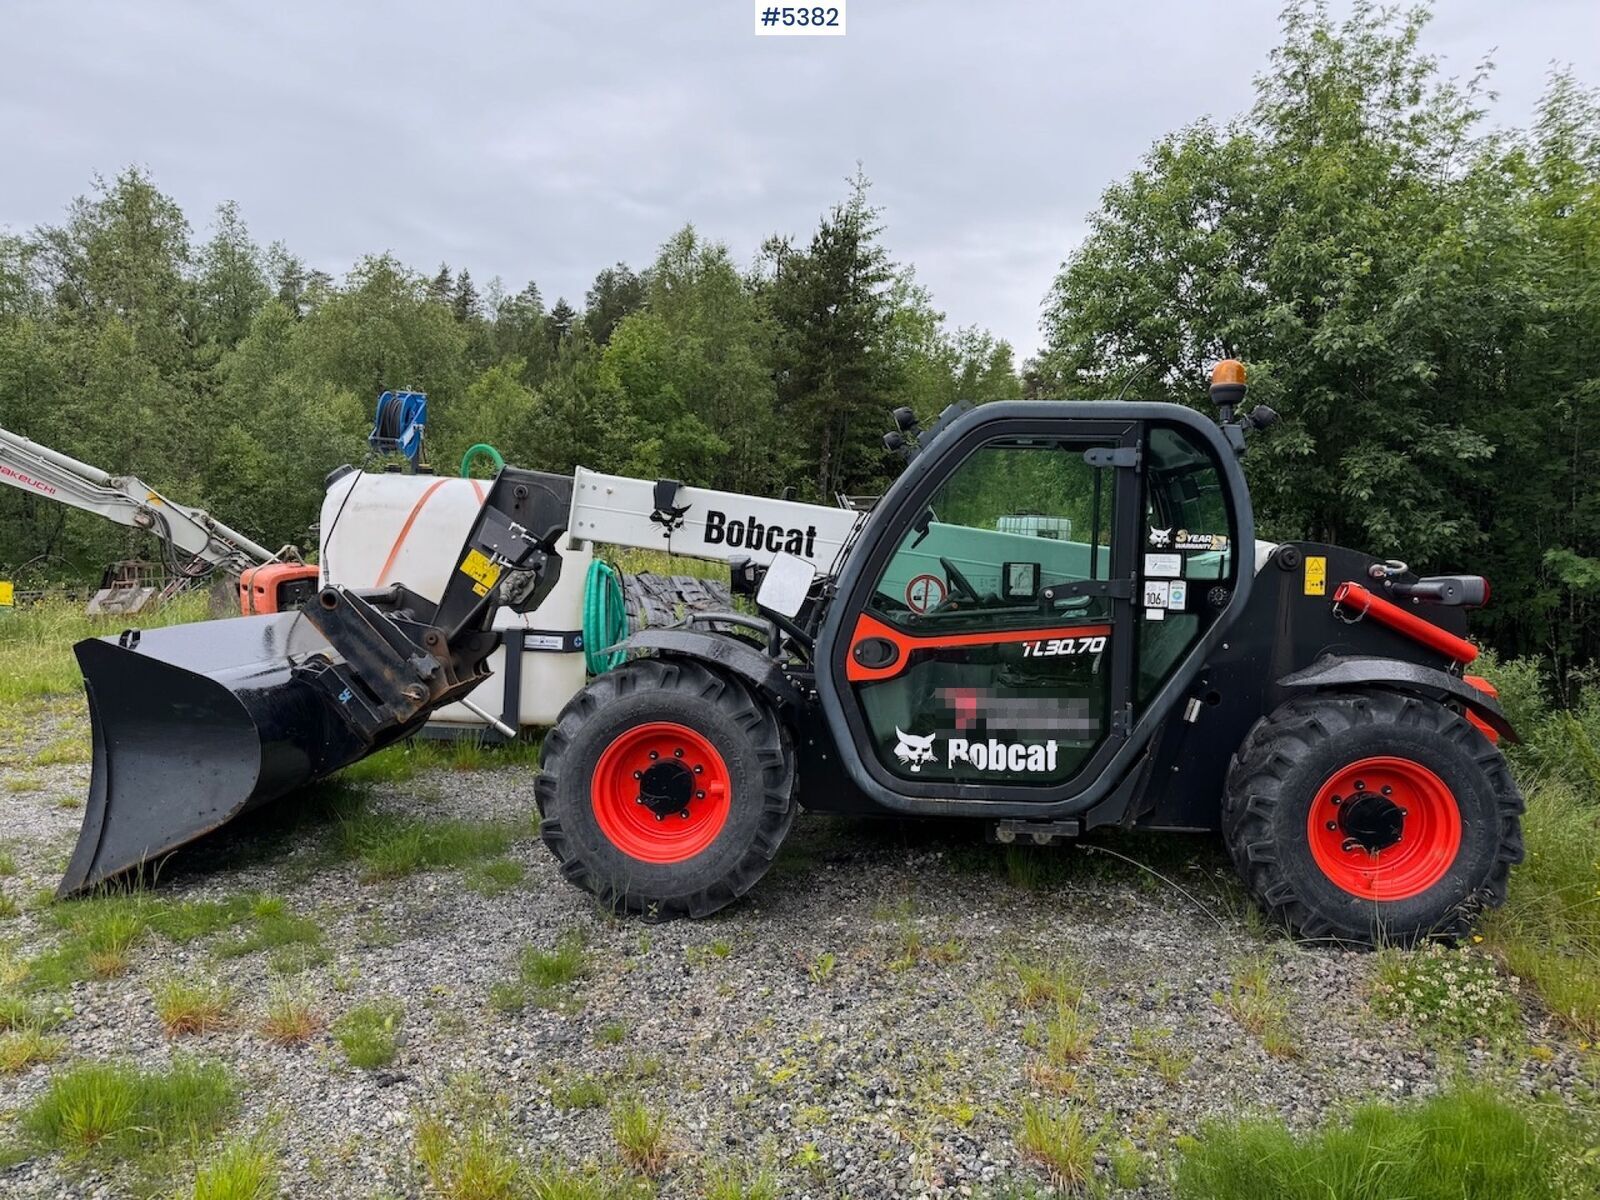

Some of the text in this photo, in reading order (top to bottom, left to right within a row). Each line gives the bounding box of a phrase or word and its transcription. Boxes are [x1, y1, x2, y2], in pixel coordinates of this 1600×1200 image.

[704, 510, 817, 558] Bobcat
[1175, 529, 1212, 542] 3 YEAR
